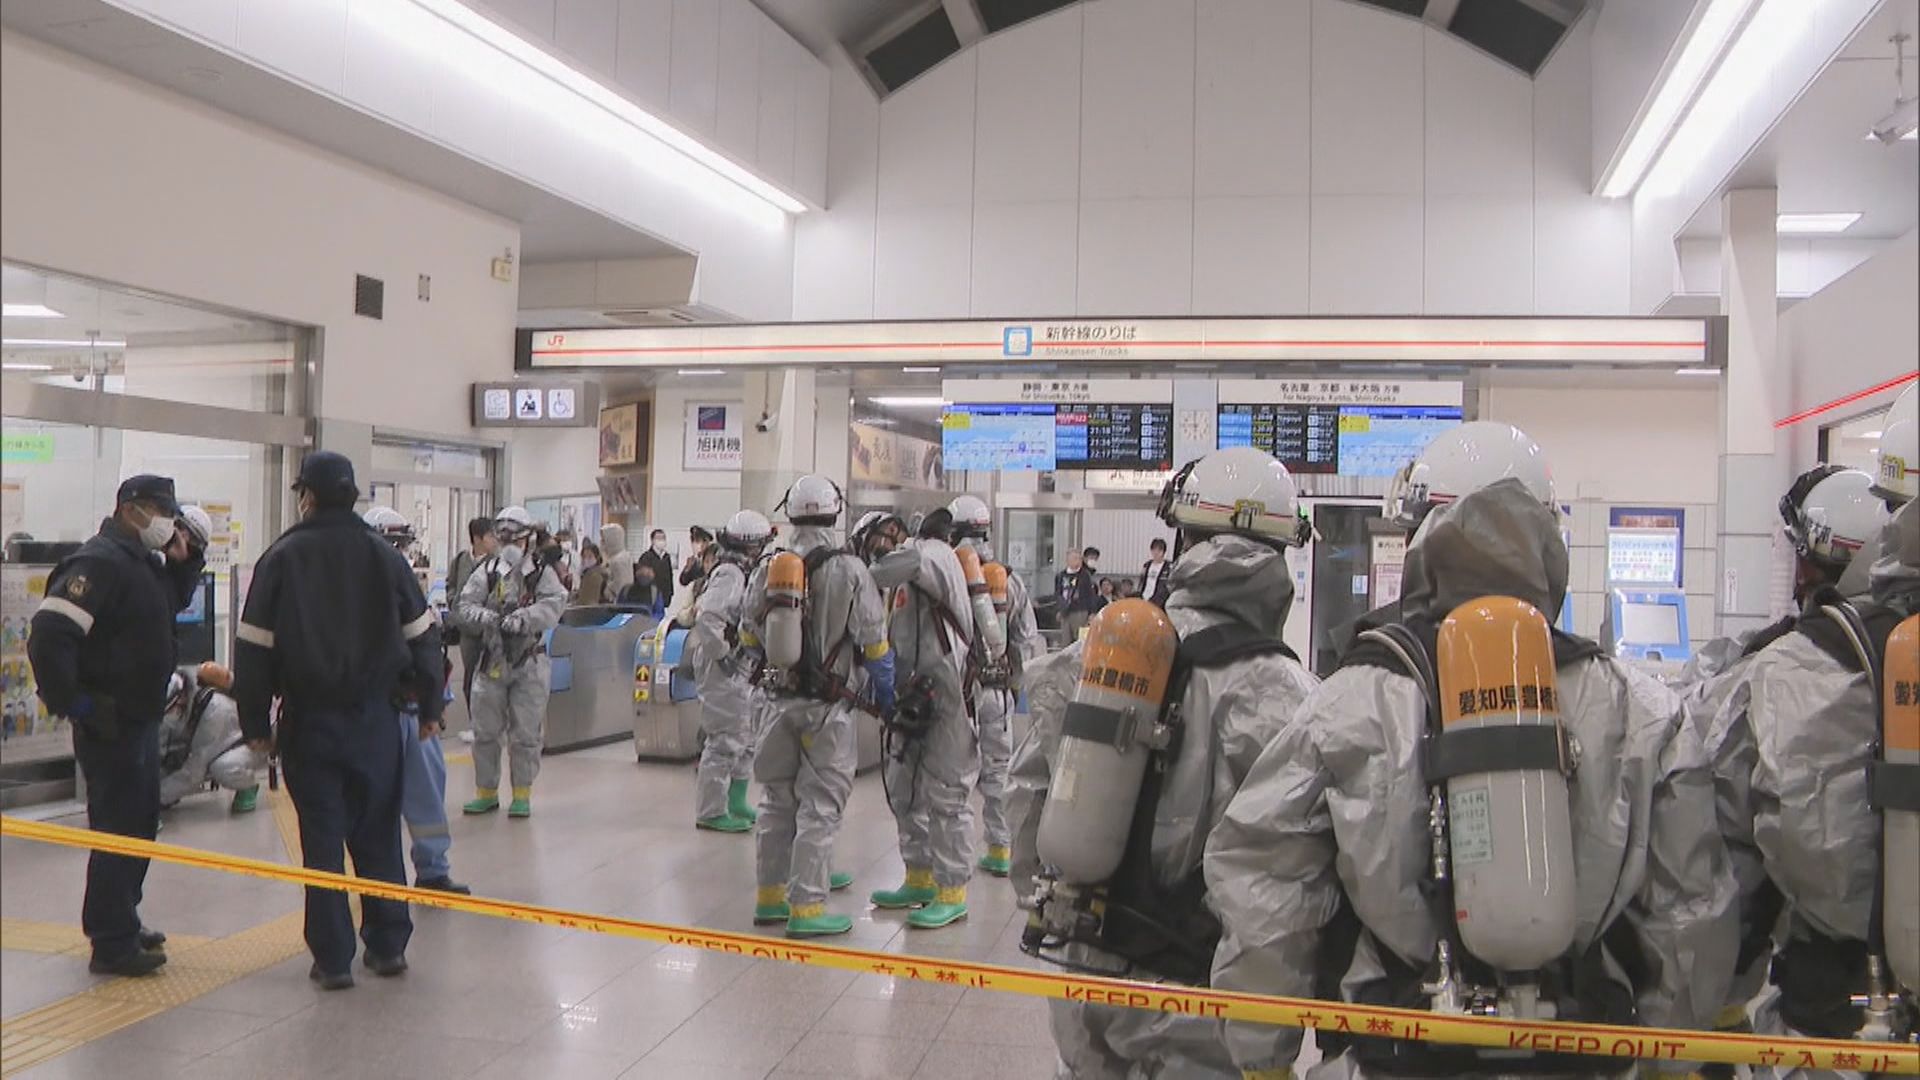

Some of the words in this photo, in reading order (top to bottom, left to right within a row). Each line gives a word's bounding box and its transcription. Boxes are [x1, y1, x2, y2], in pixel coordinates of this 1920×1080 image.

[1046, 326, 1137, 341] 新幹線のりば
[547, 335, 564, 345] JR
[1046, 347, 1095, 356] Shinkansen
[1100, 347, 1129, 356] Tracks
[697, 437, 741, 452] 旭精機
